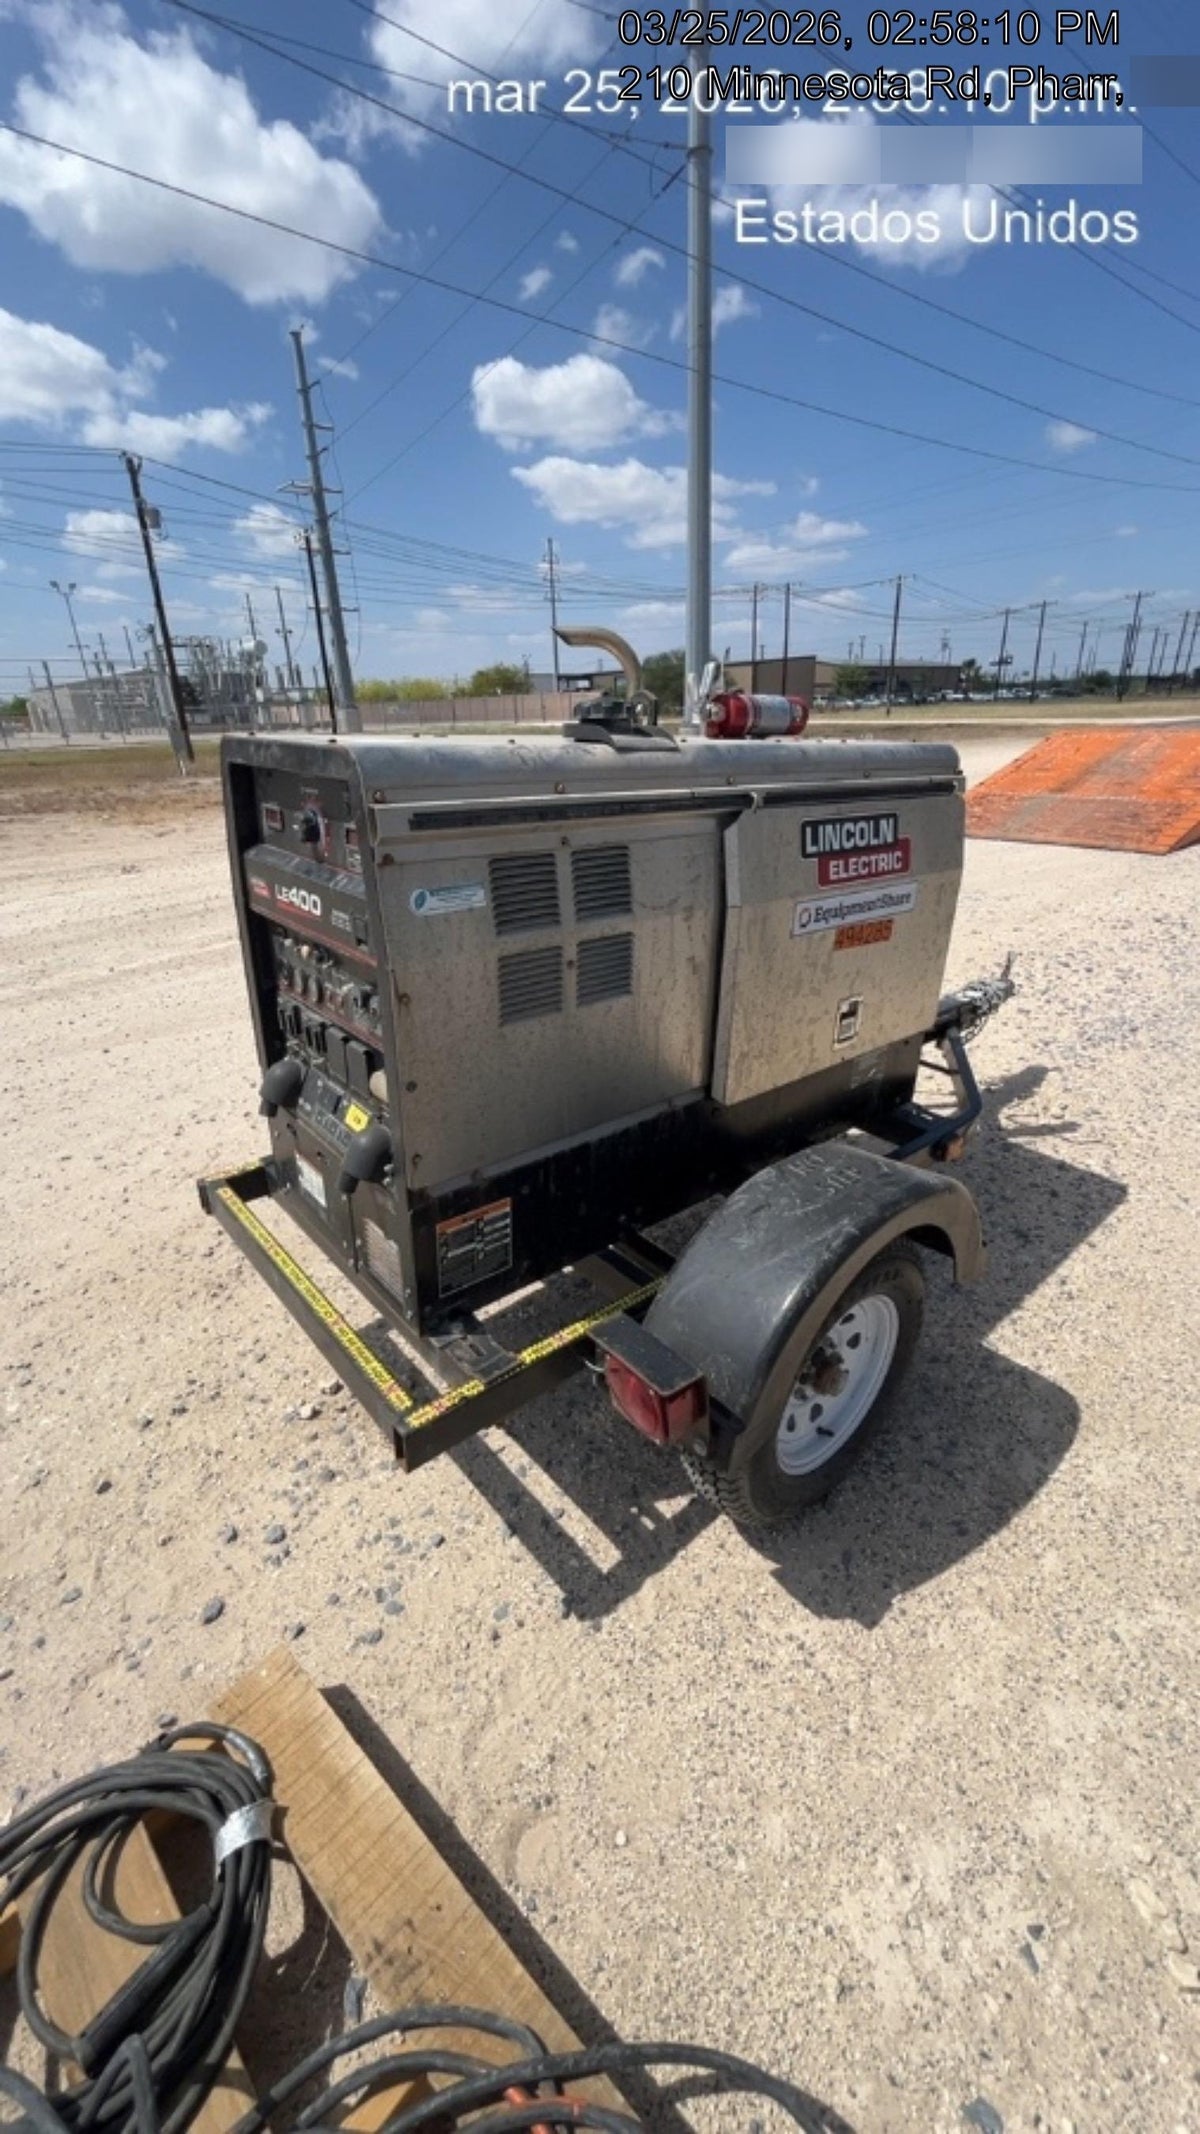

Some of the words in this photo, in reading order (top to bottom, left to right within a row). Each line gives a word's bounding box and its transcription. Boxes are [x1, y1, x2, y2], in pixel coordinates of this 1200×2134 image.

[805, 818, 895, 854] LINCOLN
[829, 851, 902, 880] ELECTRIC
[275, 884, 322, 916] LE400
[813, 892, 912, 924] EquipmentShare
